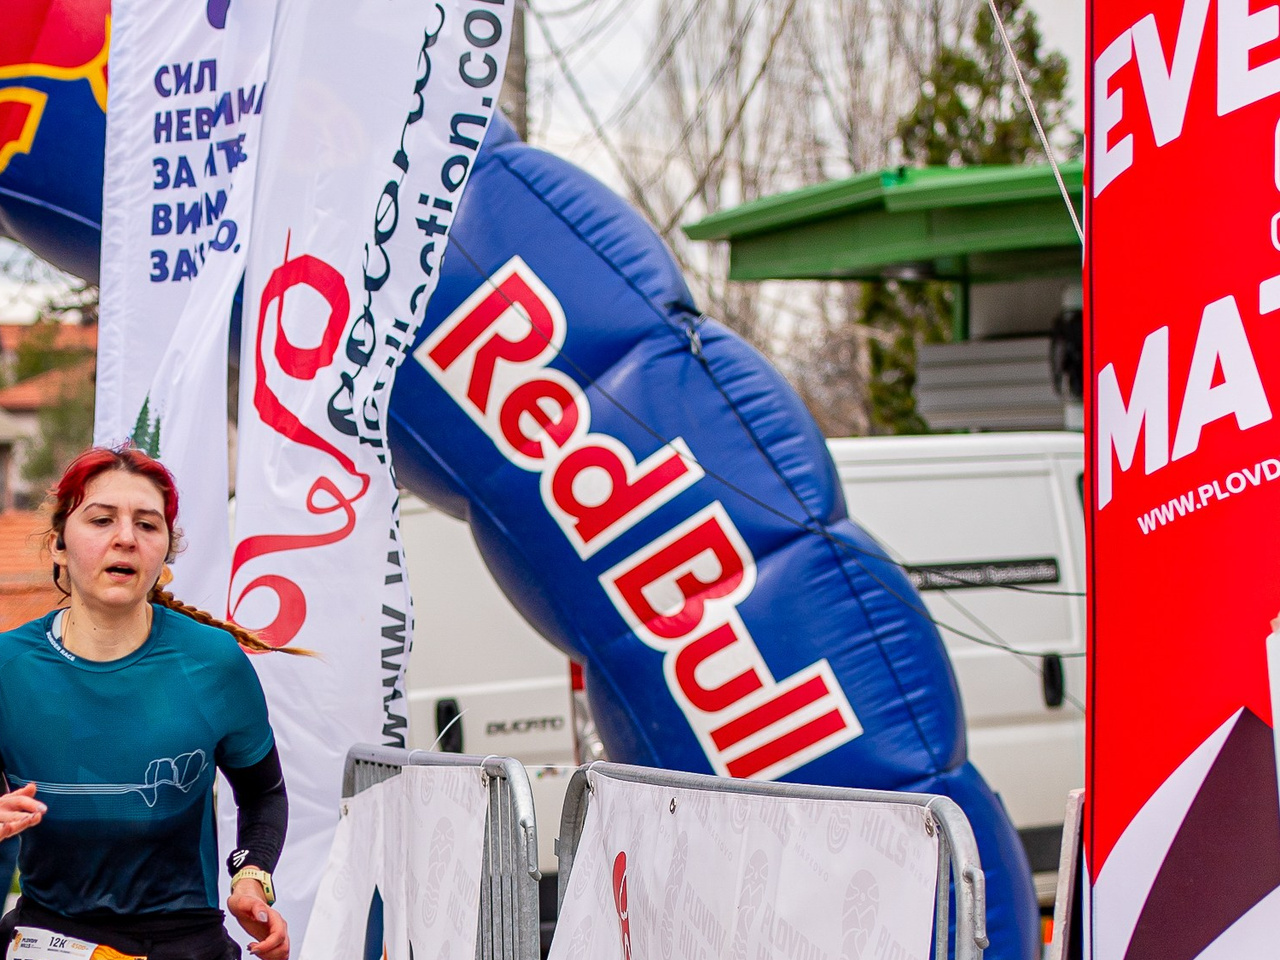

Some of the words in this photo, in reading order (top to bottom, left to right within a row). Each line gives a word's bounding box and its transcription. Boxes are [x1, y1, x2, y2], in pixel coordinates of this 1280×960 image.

[1097, 275, 1280, 511] MA
[427, 270, 689, 545] Red
[612, 515, 849, 780] Bull
[49, 936, 67, 949] 12K
